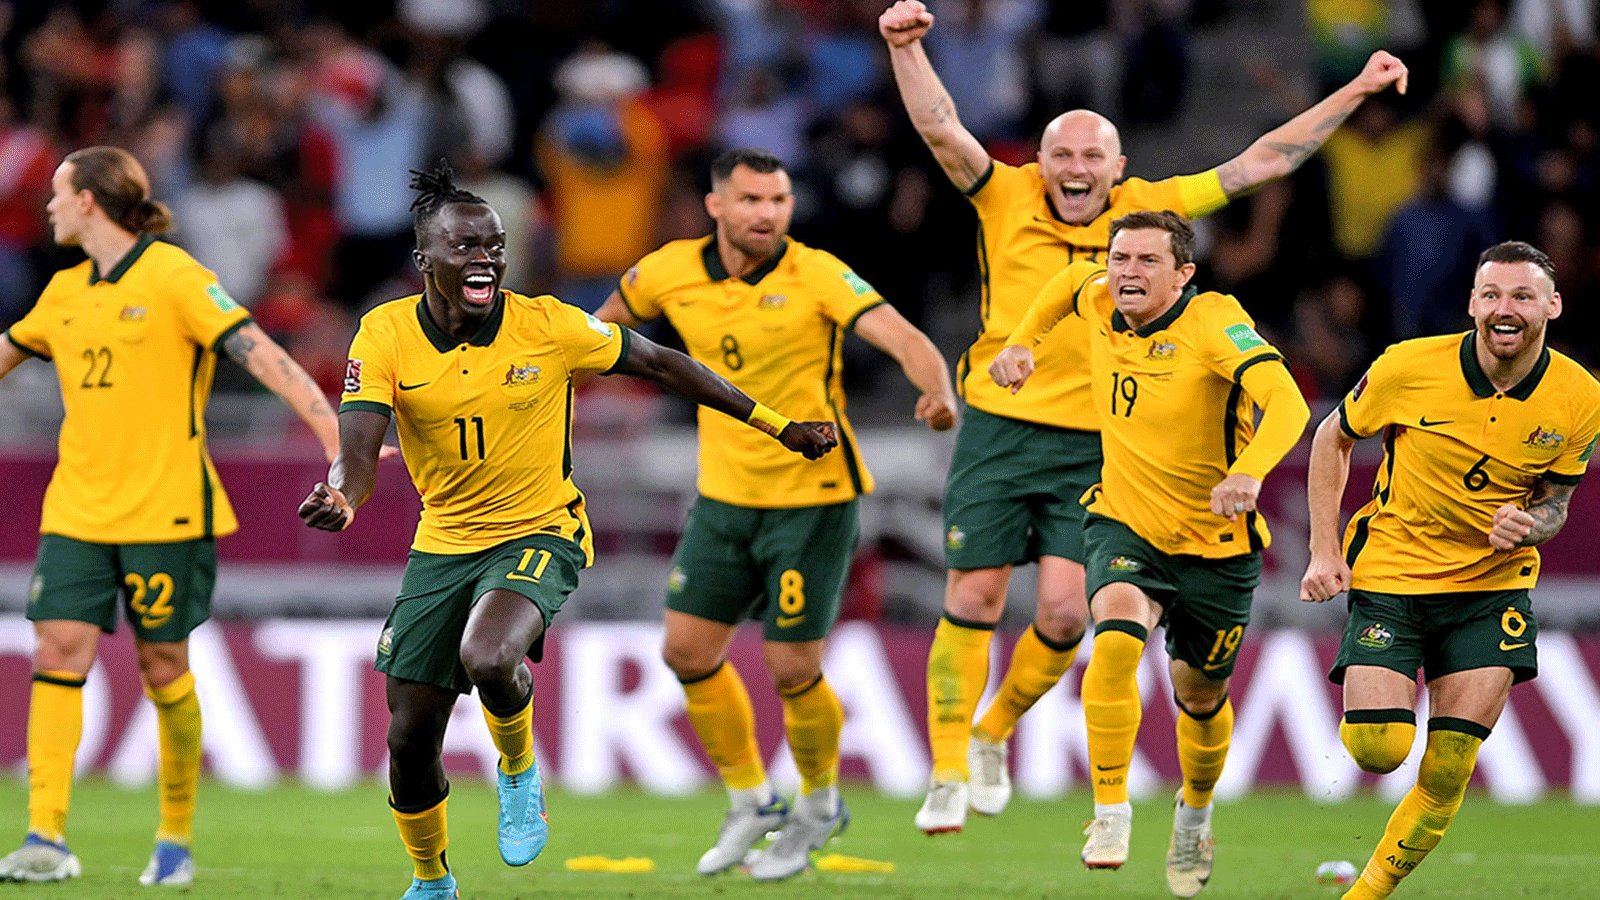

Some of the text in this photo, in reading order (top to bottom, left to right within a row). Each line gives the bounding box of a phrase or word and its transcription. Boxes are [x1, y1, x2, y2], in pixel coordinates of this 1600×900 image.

[81, 347, 113, 388] 22
[721, 334, 743, 371] 8
[1112, 372, 1138, 417] 19
[454, 417, 485, 460] 11
[1464, 455, 1491, 492] 6
[517, 548, 552, 577] 11
[125, 573, 174, 617] 22
[780, 570, 805, 614] 8
[1207, 625, 1244, 661] 19
[764, 617, 1600, 803] ARWA
[1098, 776, 1124, 786] AUS
[1386, 855, 1417, 871] AUS
